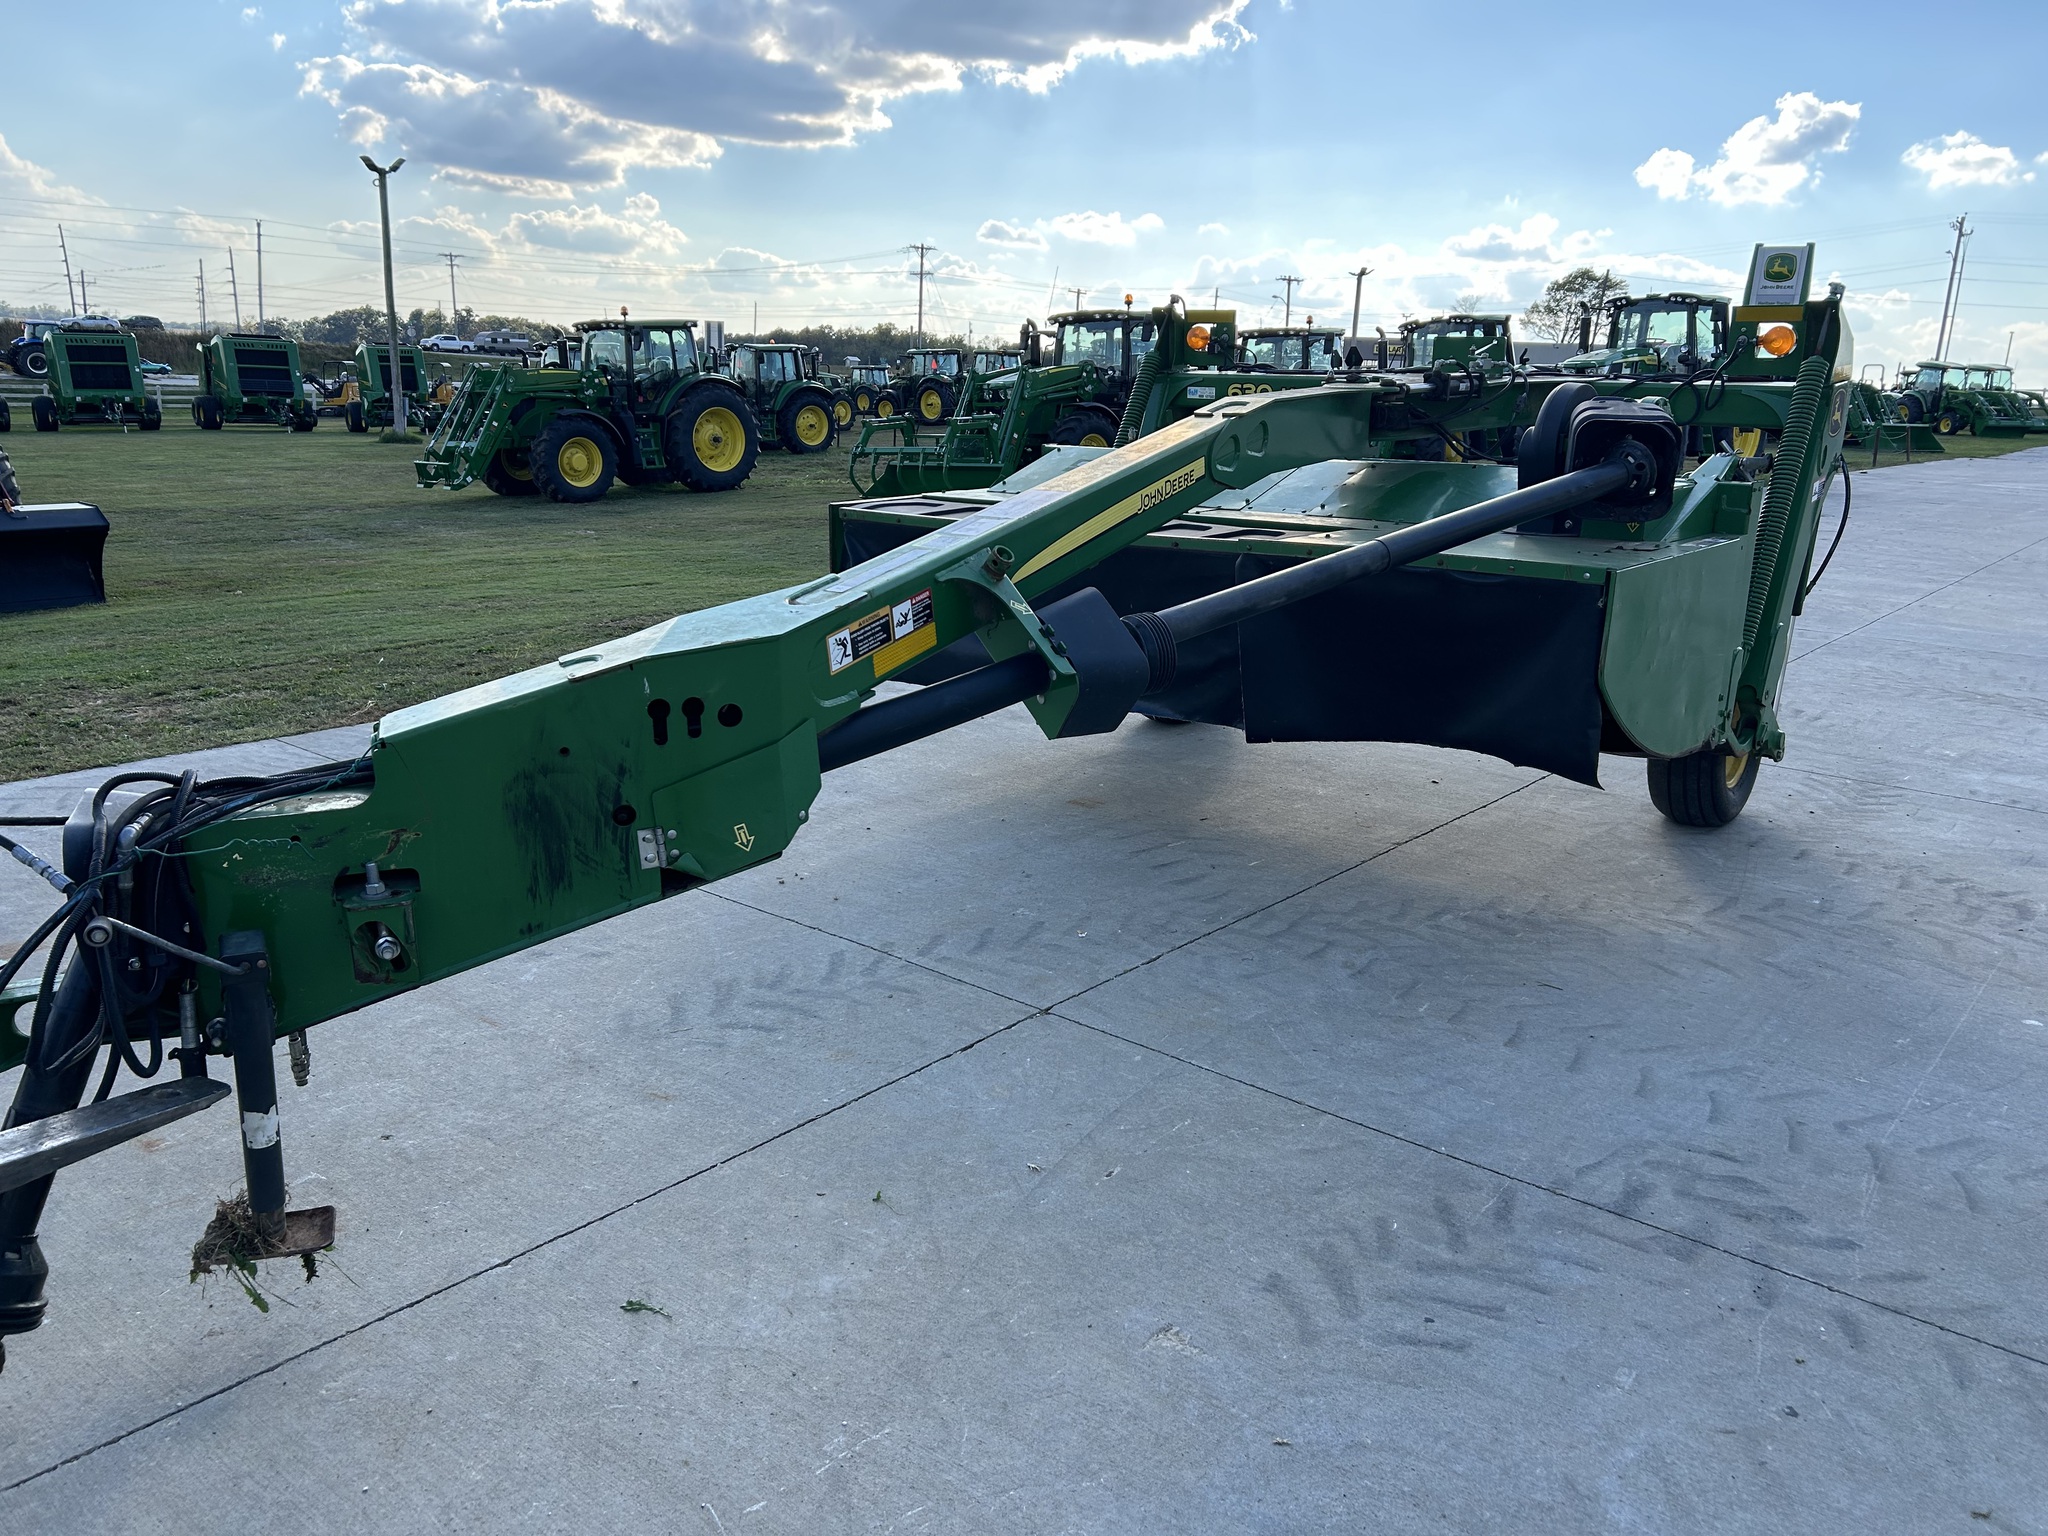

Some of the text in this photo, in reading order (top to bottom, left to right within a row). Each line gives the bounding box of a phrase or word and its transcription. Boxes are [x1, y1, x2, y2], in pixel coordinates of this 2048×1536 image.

[1137, 468, 1196, 513] JOHN DEERE
[915, 590, 930, 602] DANGER
[861, 612, 881, 626] WARNING
